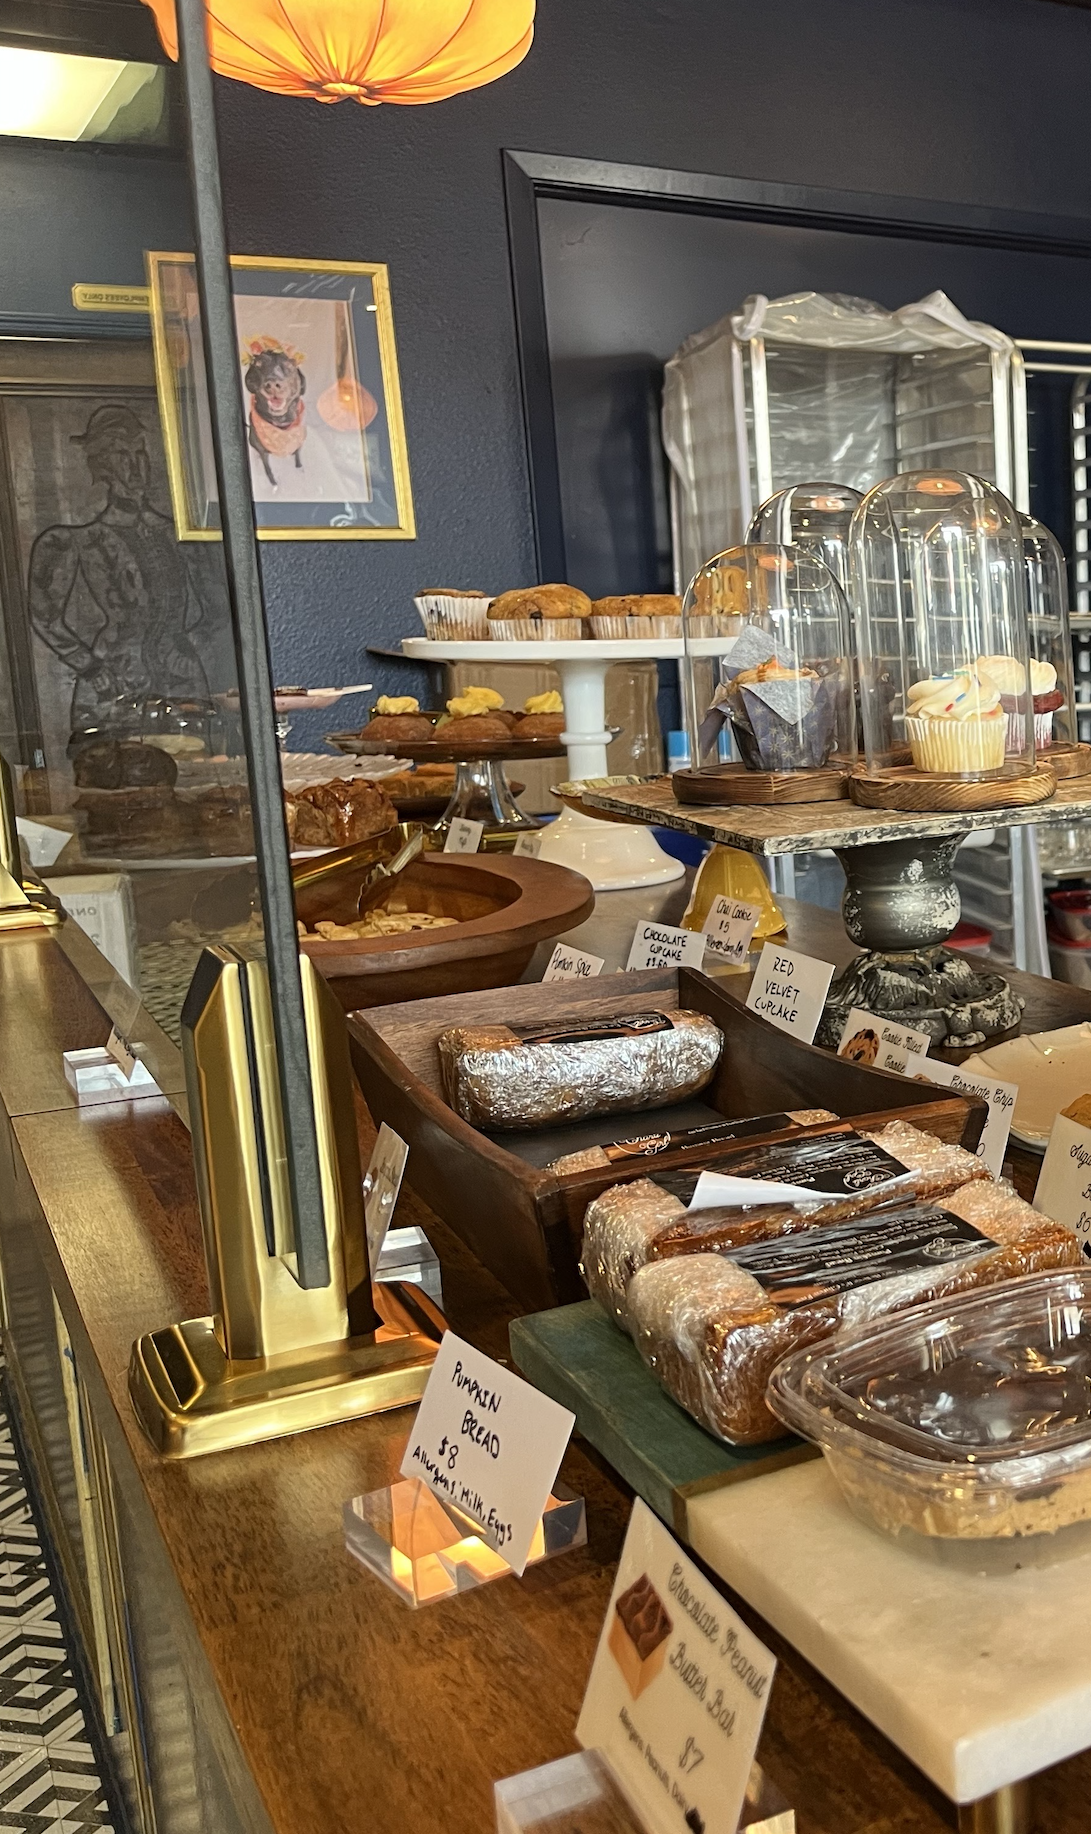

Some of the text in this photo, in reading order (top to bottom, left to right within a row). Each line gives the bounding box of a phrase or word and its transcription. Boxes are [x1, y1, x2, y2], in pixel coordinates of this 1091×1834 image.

[644, 928, 688, 947] CHOCOLATE
[650, 944, 682, 961] CUPCAKE
[772, 956, 795, 977] RED
[764, 979, 801, 1005] VELVET
[754, 996, 799, 1023] CUPCAKE
[992, 1088, 1013, 1112] Chip
[451, 1360, 502, 1413] PUMPKIN
[461, 1409, 500, 1460] BREAD
[438, 1436, 459, 1469] $8
[487, 1508, 513, 1546] Eggs
[668, 1562, 769, 1699] Chocolate Peanut
[669, 1641, 736, 1738] Butter Bar
[678, 1735, 705, 1774] $7
